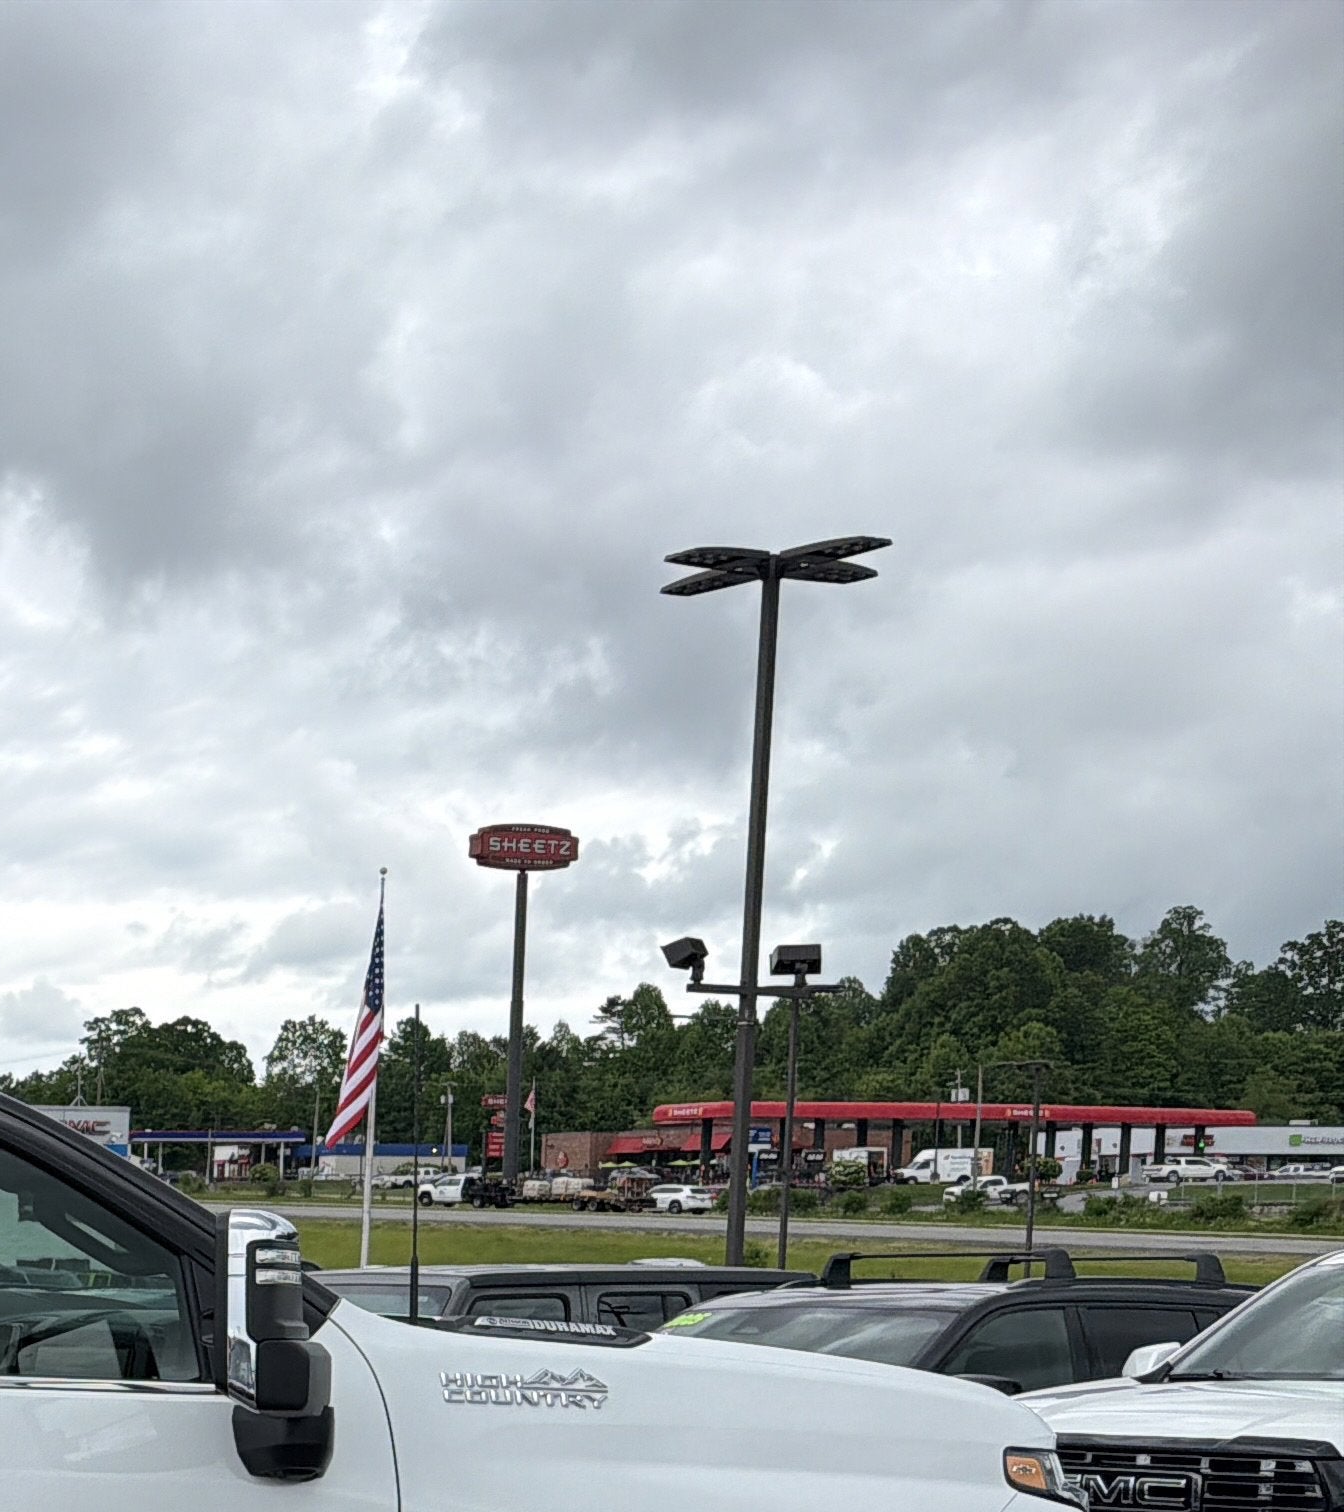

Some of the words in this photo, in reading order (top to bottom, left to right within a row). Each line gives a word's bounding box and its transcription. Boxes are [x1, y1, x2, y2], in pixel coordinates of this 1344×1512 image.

[489, 836, 571, 855] SHEETZ
[439, 1371, 523, 1388] HIGH
[442, 1388, 608, 1409] COUNTRY
